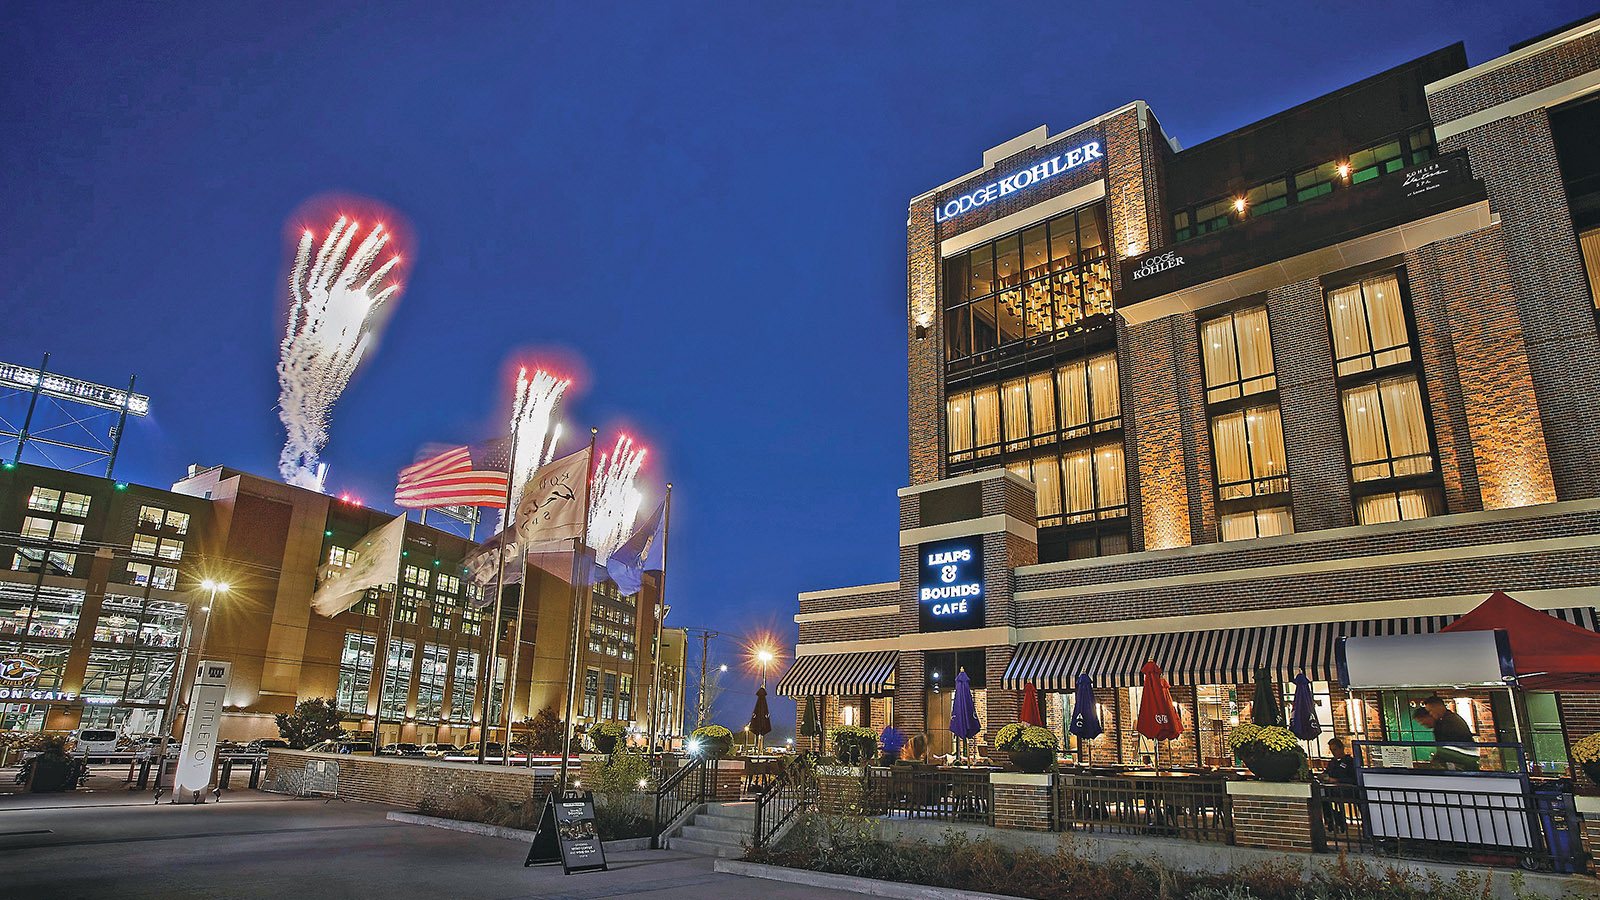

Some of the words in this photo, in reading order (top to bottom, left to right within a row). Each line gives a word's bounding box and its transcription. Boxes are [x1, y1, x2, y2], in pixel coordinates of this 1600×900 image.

[936, 183, 997, 223] LODGE
[999, 142, 1103, 197] KOHLER
[1133, 256, 1185, 280] KOHLER
[1140, 251, 1174, 268] LODGE
[928, 549, 971, 566] LEAPS
[941, 565, 957, 583] &
[921, 583, 980, 600] BOUNDS
[932, 599, 967, 615] CAFÉ
[31, 690, 76, 700] GATE
